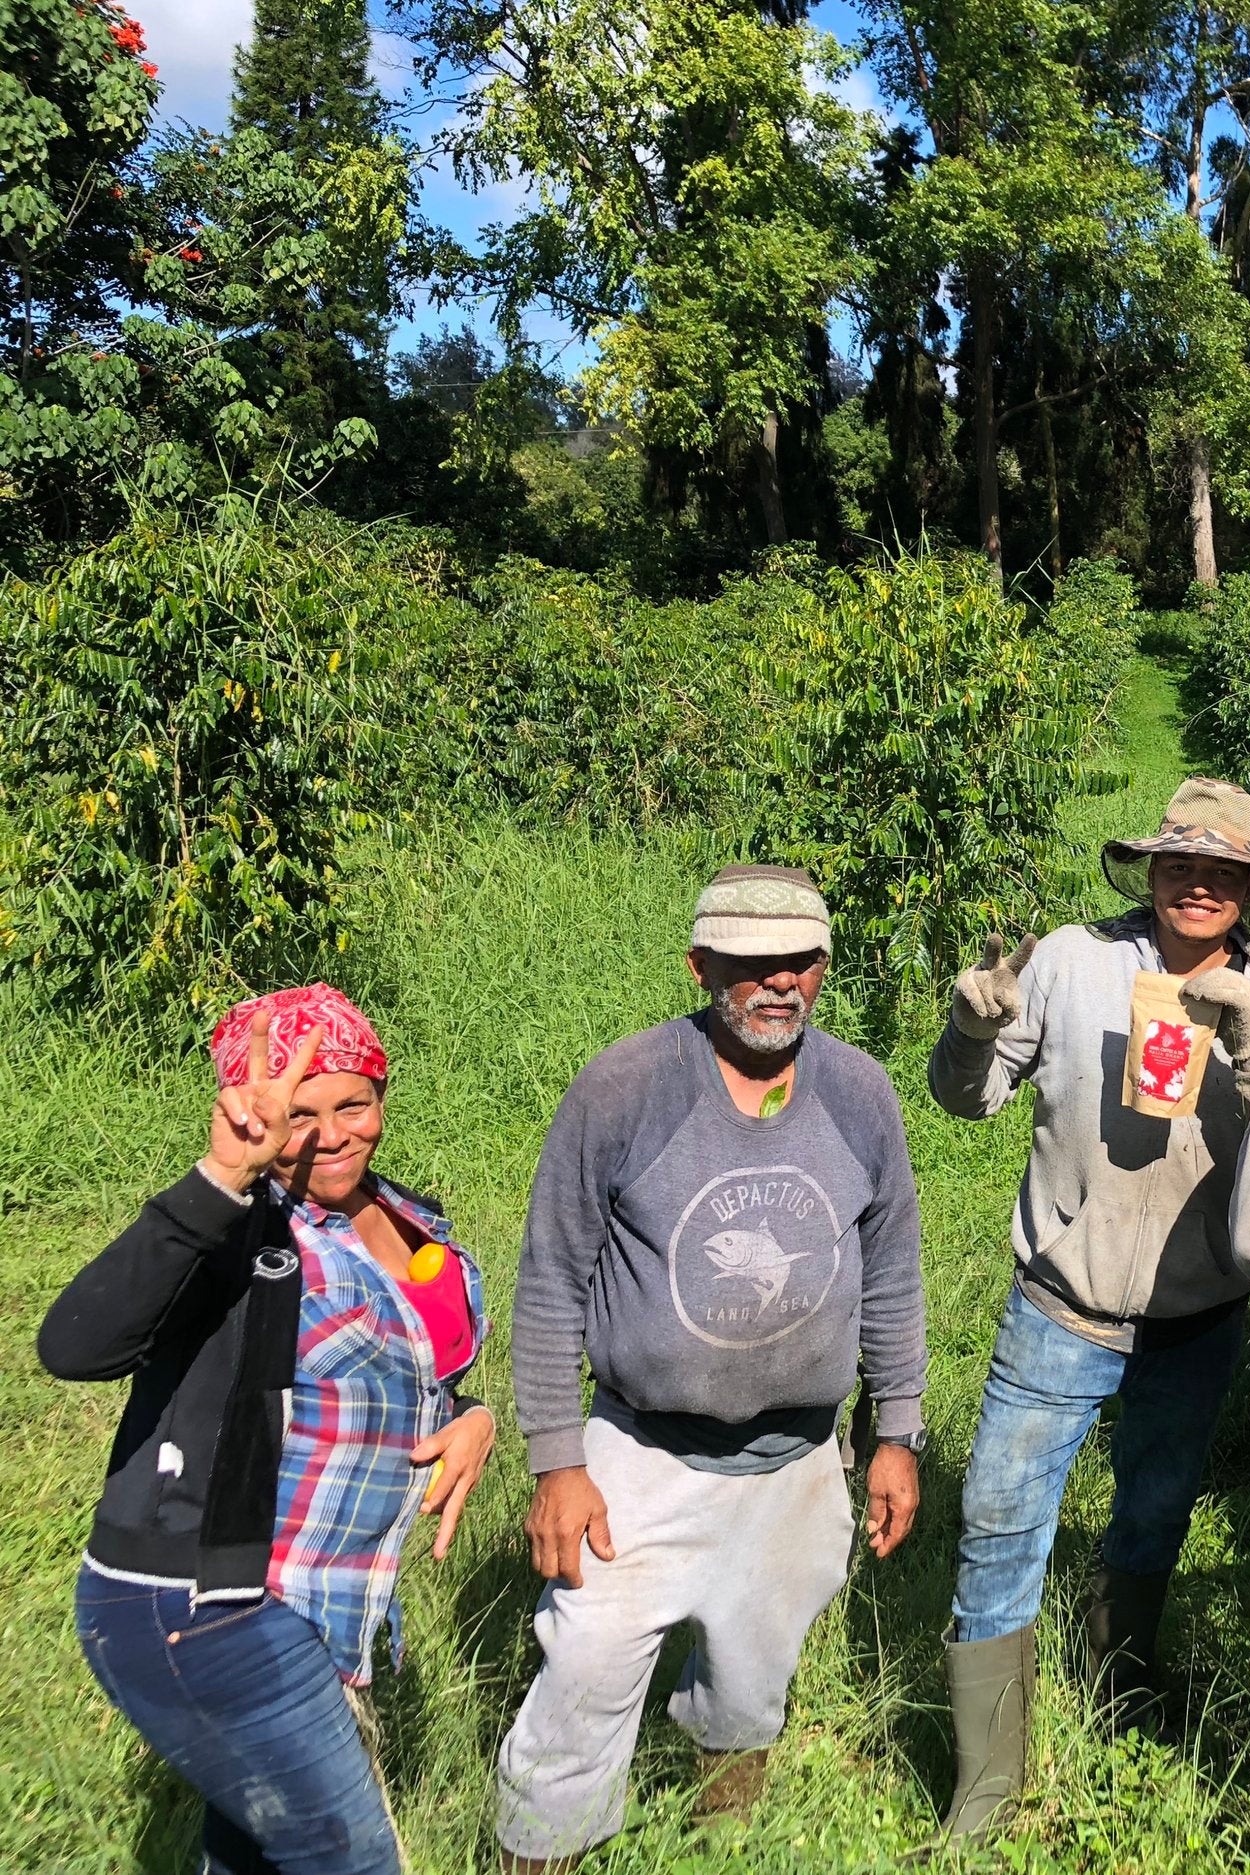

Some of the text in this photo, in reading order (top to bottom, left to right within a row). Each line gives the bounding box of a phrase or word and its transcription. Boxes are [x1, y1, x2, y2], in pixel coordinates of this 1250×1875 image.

[709, 1181, 815, 1223] DEPACTUS
[706, 1294, 810, 1321] LAND SEA
